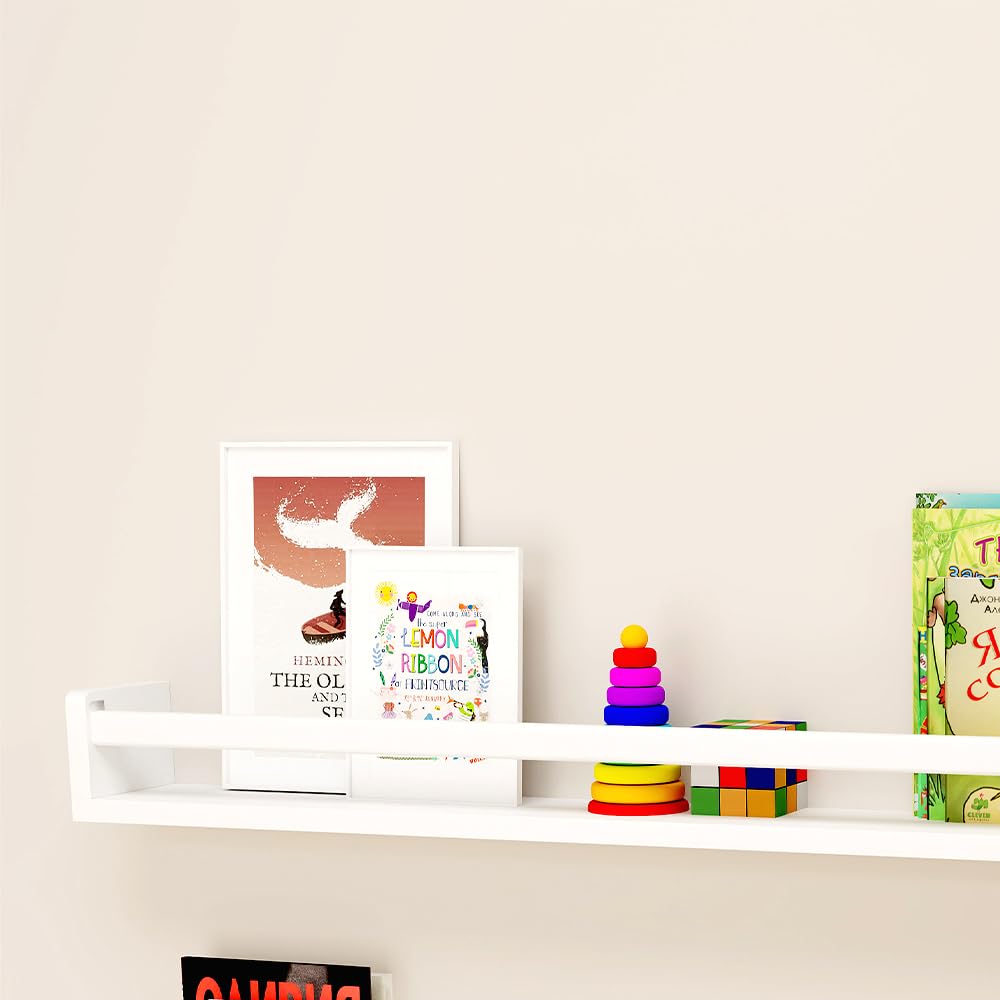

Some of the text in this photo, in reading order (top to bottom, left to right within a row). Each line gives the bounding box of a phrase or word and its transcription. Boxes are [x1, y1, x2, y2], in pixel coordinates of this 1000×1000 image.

[401, 628, 459, 649] LEMON
[293, 655, 346, 667] HEMIN
[401, 653, 463, 674] RIBBON
[270, 672, 345, 688] THE OL
[312, 692, 339, 703] AND
[322, 706, 344, 718] SE
